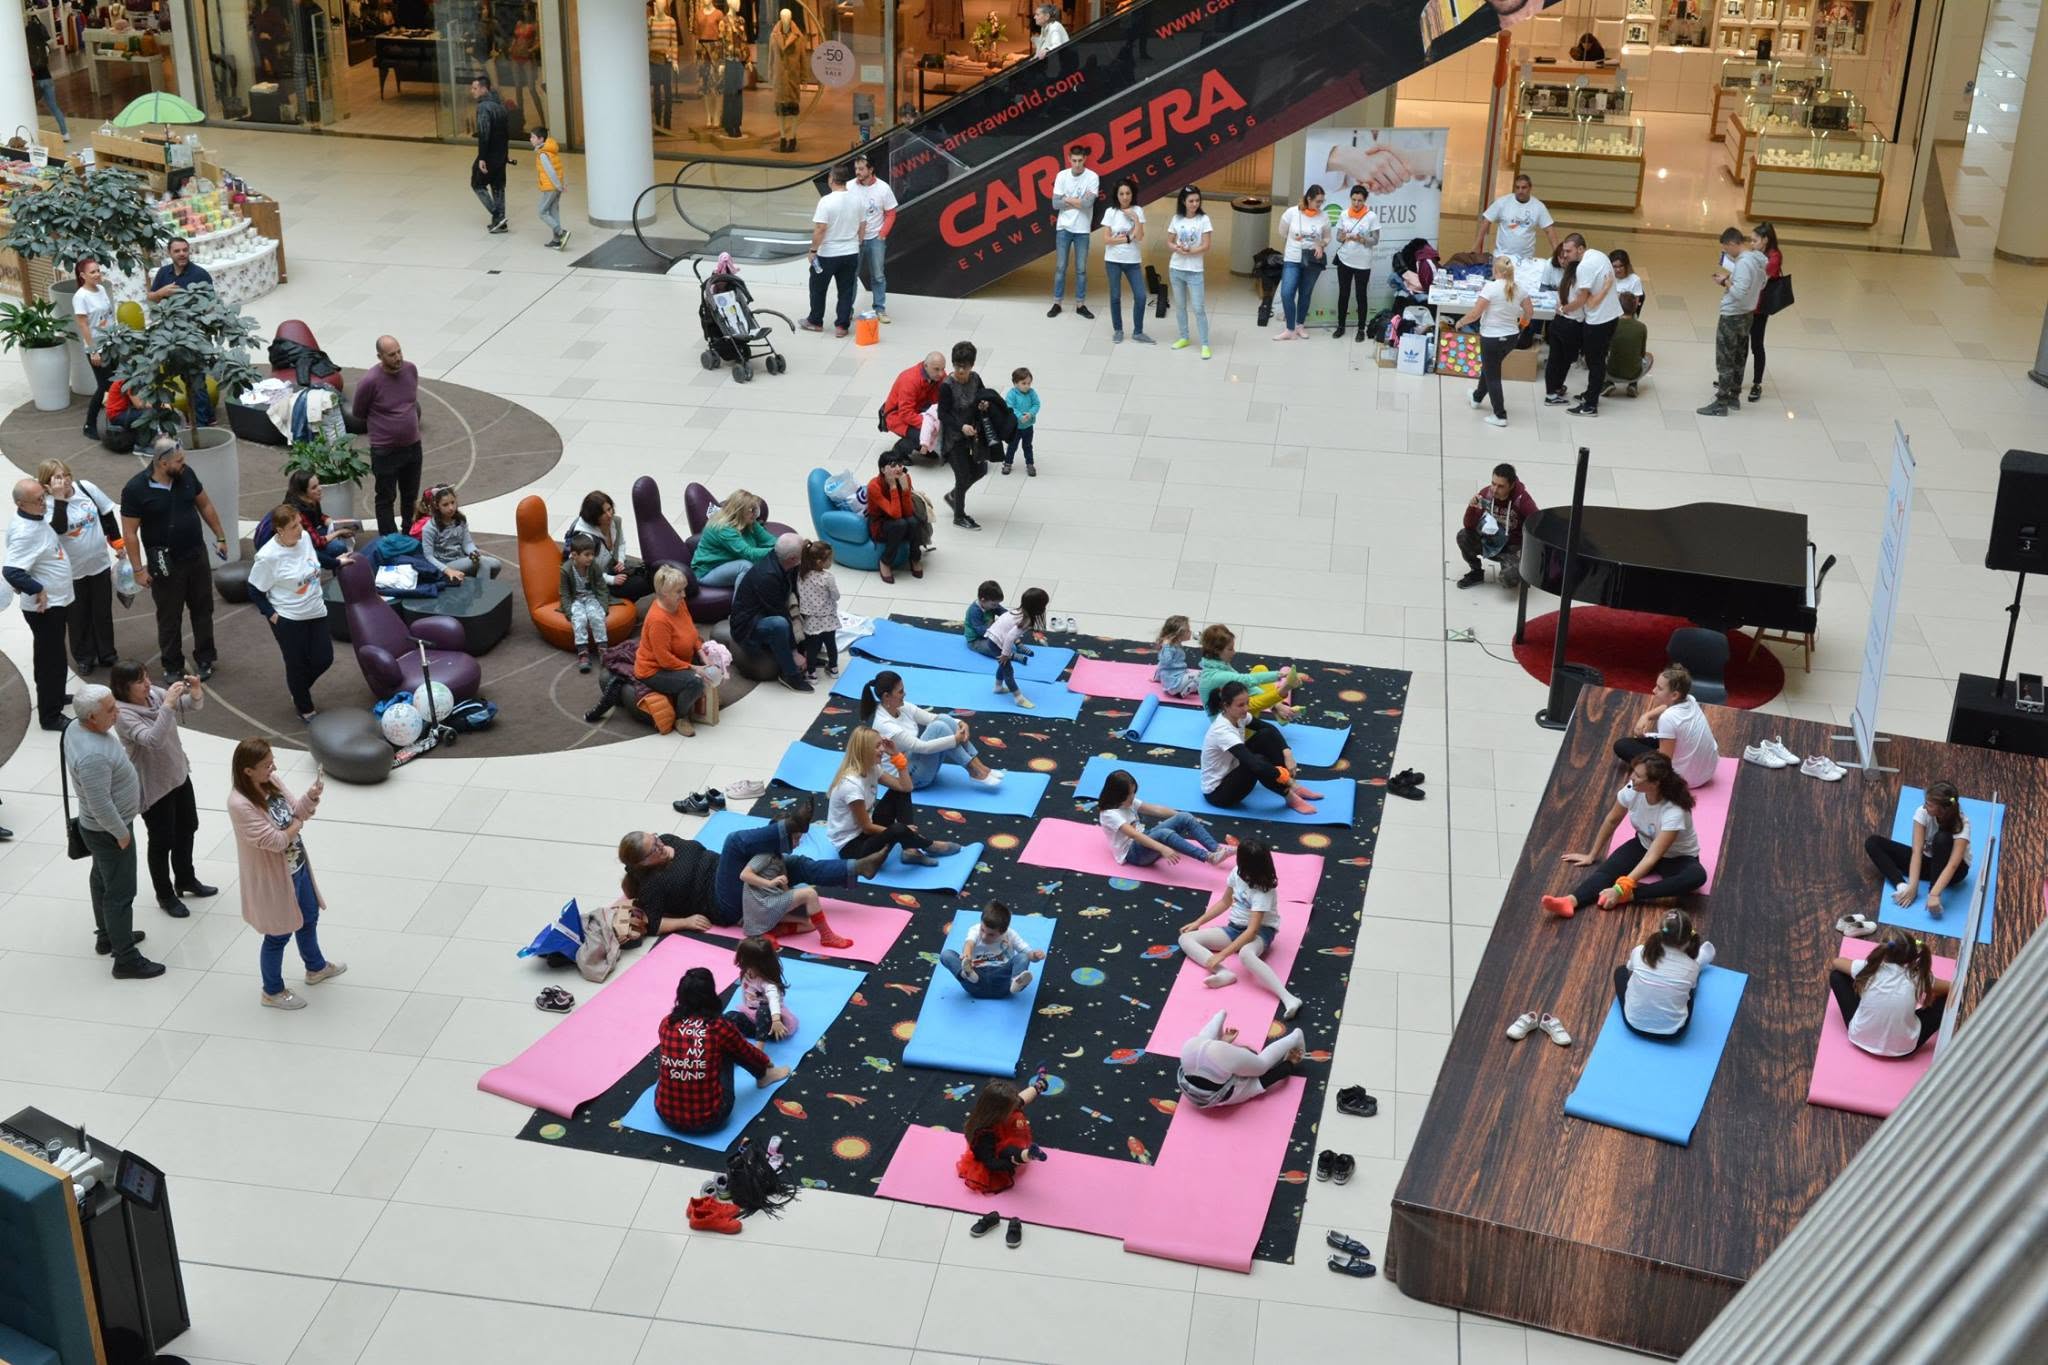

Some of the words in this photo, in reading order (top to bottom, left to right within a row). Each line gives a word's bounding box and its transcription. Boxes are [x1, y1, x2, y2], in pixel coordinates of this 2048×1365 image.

[889, 69, 1086, 179] www.carreraworld.com
[1194, 115, 1256, 152] 1956
[939, 68, 1248, 248] CARRERA
[2023, 540, 2031, 550] 3
[678, 1027, 707, 1037] VOICE
[694, 1038, 703, 1048] IS
[686, 1048, 705, 1059] MY
[661, 1055, 707, 1068] FAVORITE
[670, 1069, 706, 1081] SOUND
